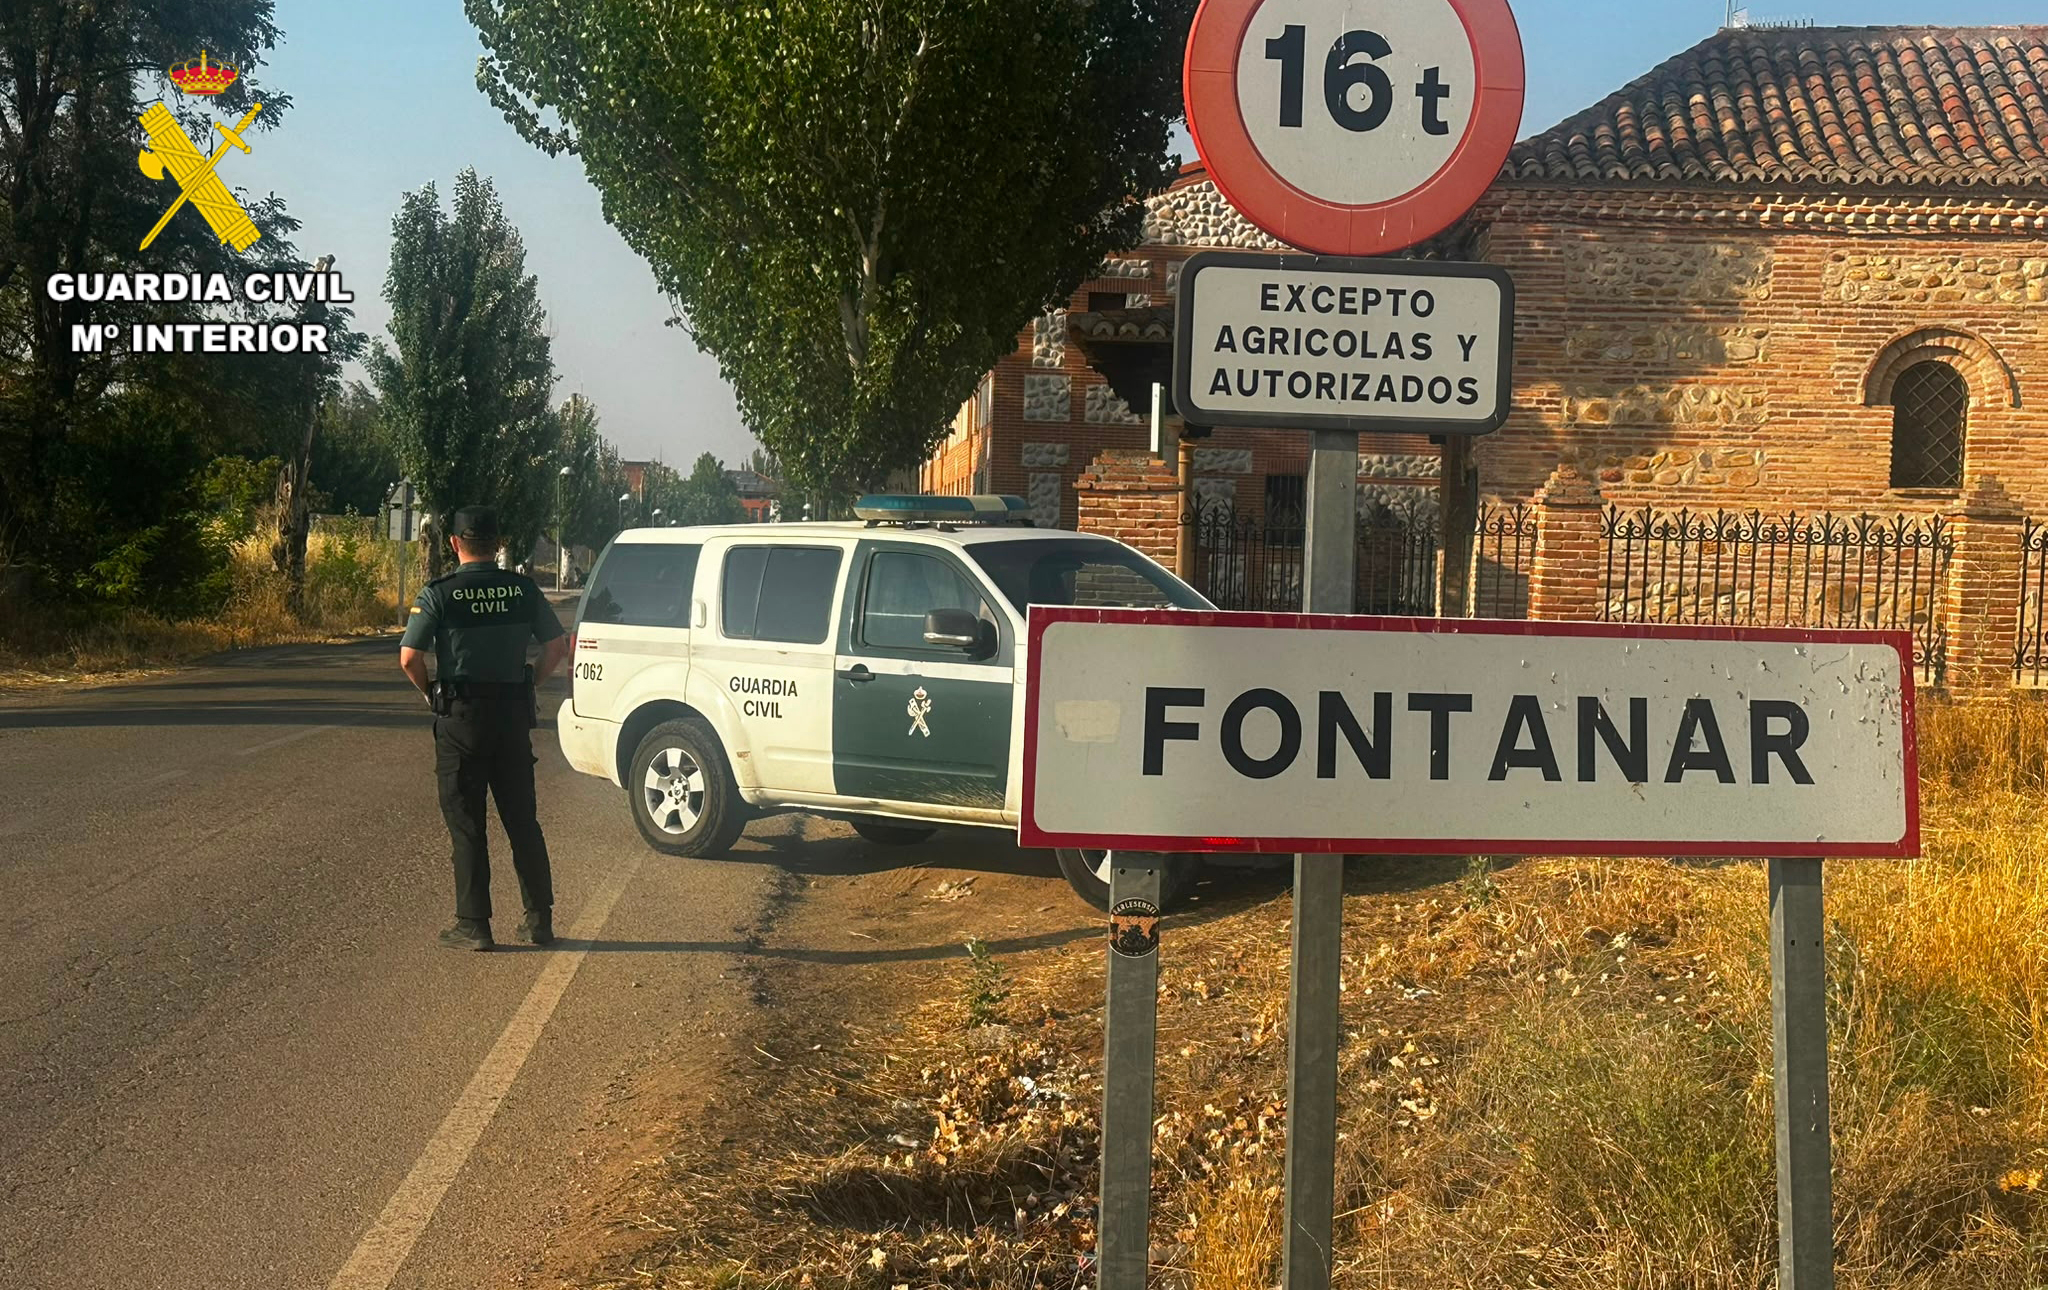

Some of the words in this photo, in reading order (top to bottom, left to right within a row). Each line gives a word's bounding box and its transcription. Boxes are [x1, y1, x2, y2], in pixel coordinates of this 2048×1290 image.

[1265, 24, 1394, 132] 16
[1416, 65, 1450, 135] t
[1260, 283, 1435, 318] EXCEPTO
[1214, 325, 1433, 361] AGRICOLAS
[1457, 334, 1478, 362] Y
[1208, 367, 1480, 405] AUTORIZADOS
[452, 585, 523, 600] GUARDIA
[471, 601, 508, 614] CIVIL
[583, 662, 603, 681] 062
[729, 676, 798, 697] GUARDIA
[743, 700, 783, 718] CIVIL
[1142, 686, 1816, 786] FONTANAR
